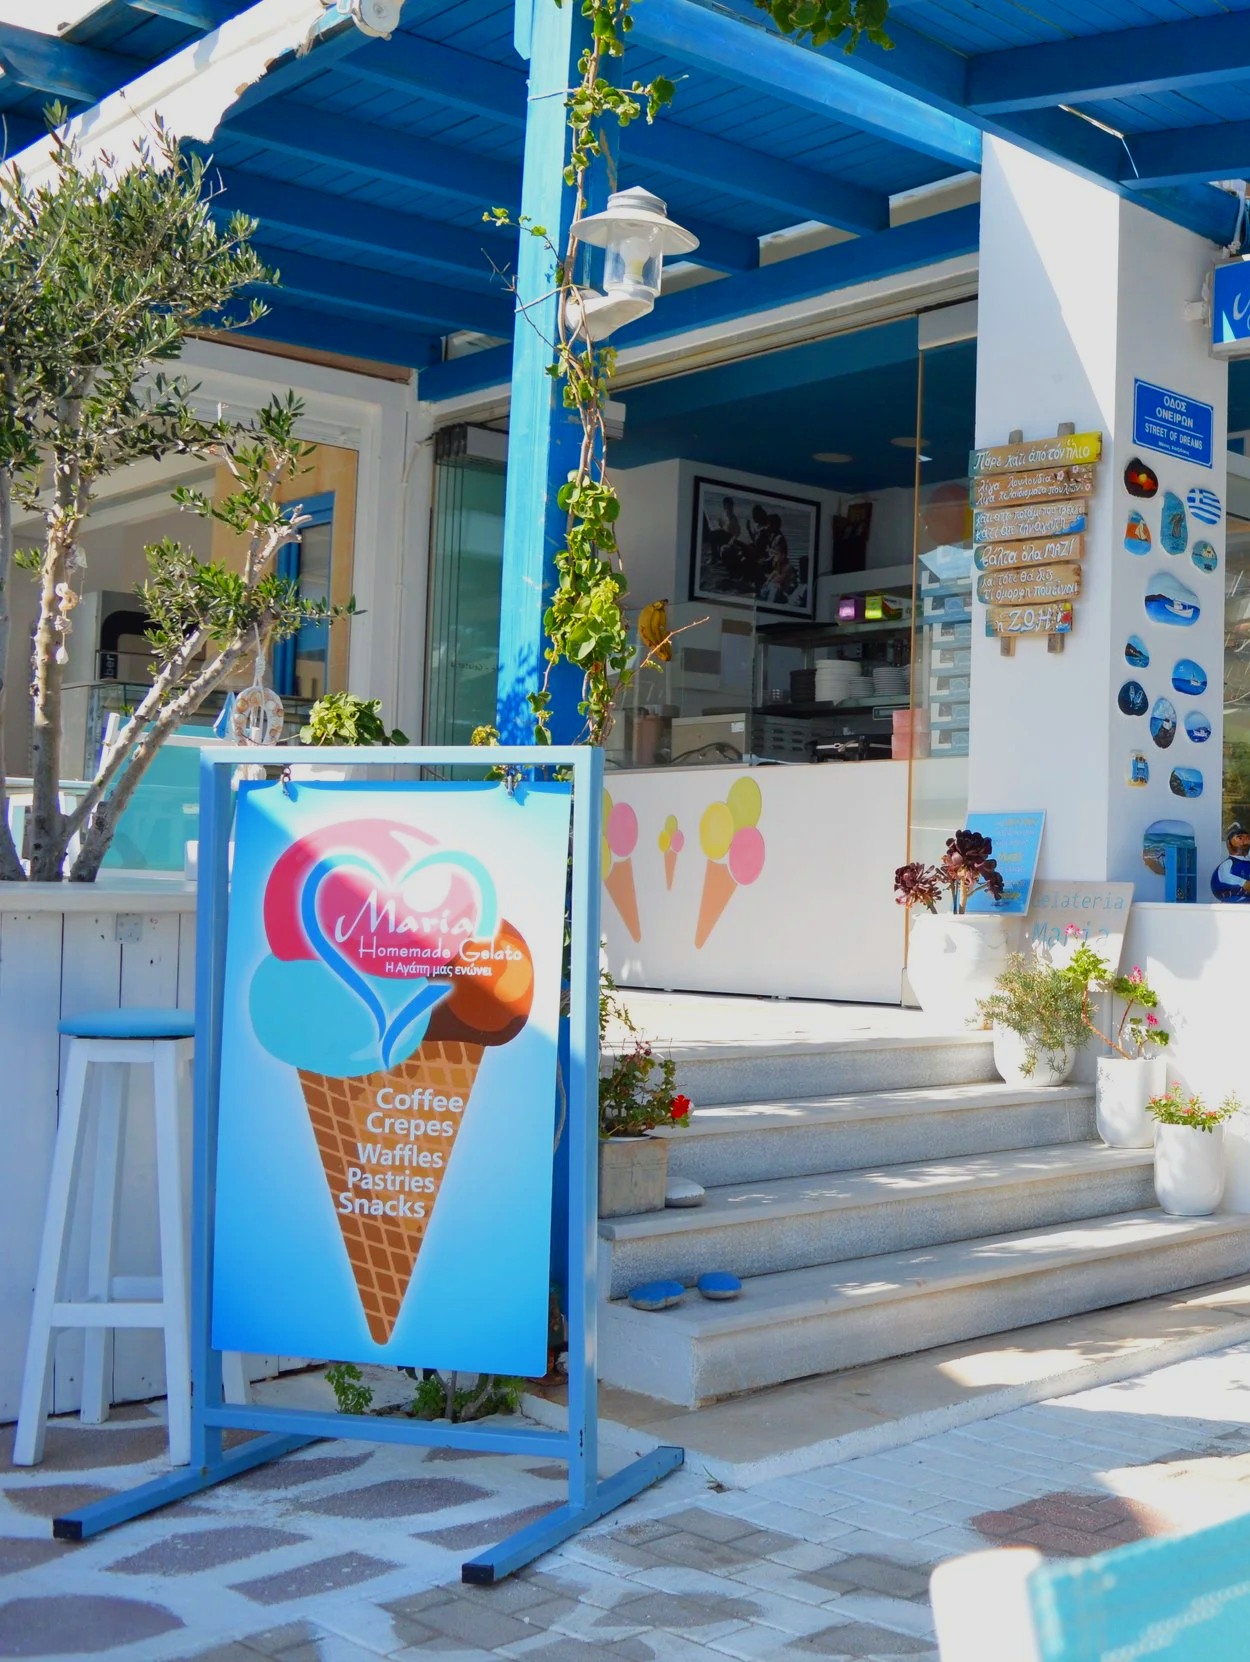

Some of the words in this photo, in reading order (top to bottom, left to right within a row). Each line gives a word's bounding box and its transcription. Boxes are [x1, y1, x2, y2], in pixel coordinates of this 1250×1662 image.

[1163, 396, 1187, 412] ΟΔΟΣ
[1156, 407, 1193, 428] ΟΝΕΙΡΩΝ
[1144, 422, 1168, 438] STREET
[1169, 431, 1178, 441] OF
[1179, 434, 1203, 450] DREAMS
[334, 888, 476, 943] Maria
[358, 936, 450, 959] Homemade
[459, 937, 522, 962] Gelato
[385, 962, 394, 973] Η
[395, 961, 430, 977] Αγάπη
[432, 965, 453, 977] μας
[455, 962, 493, 976] ενώνει
[376, 1087, 464, 1112] Coffee
[366, 1111, 454, 1141] Crepes
[357, 1142, 443, 1168] Waffles
[347, 1167, 435, 1193] Pastries
[338, 1192, 425, 1218] Snacks
